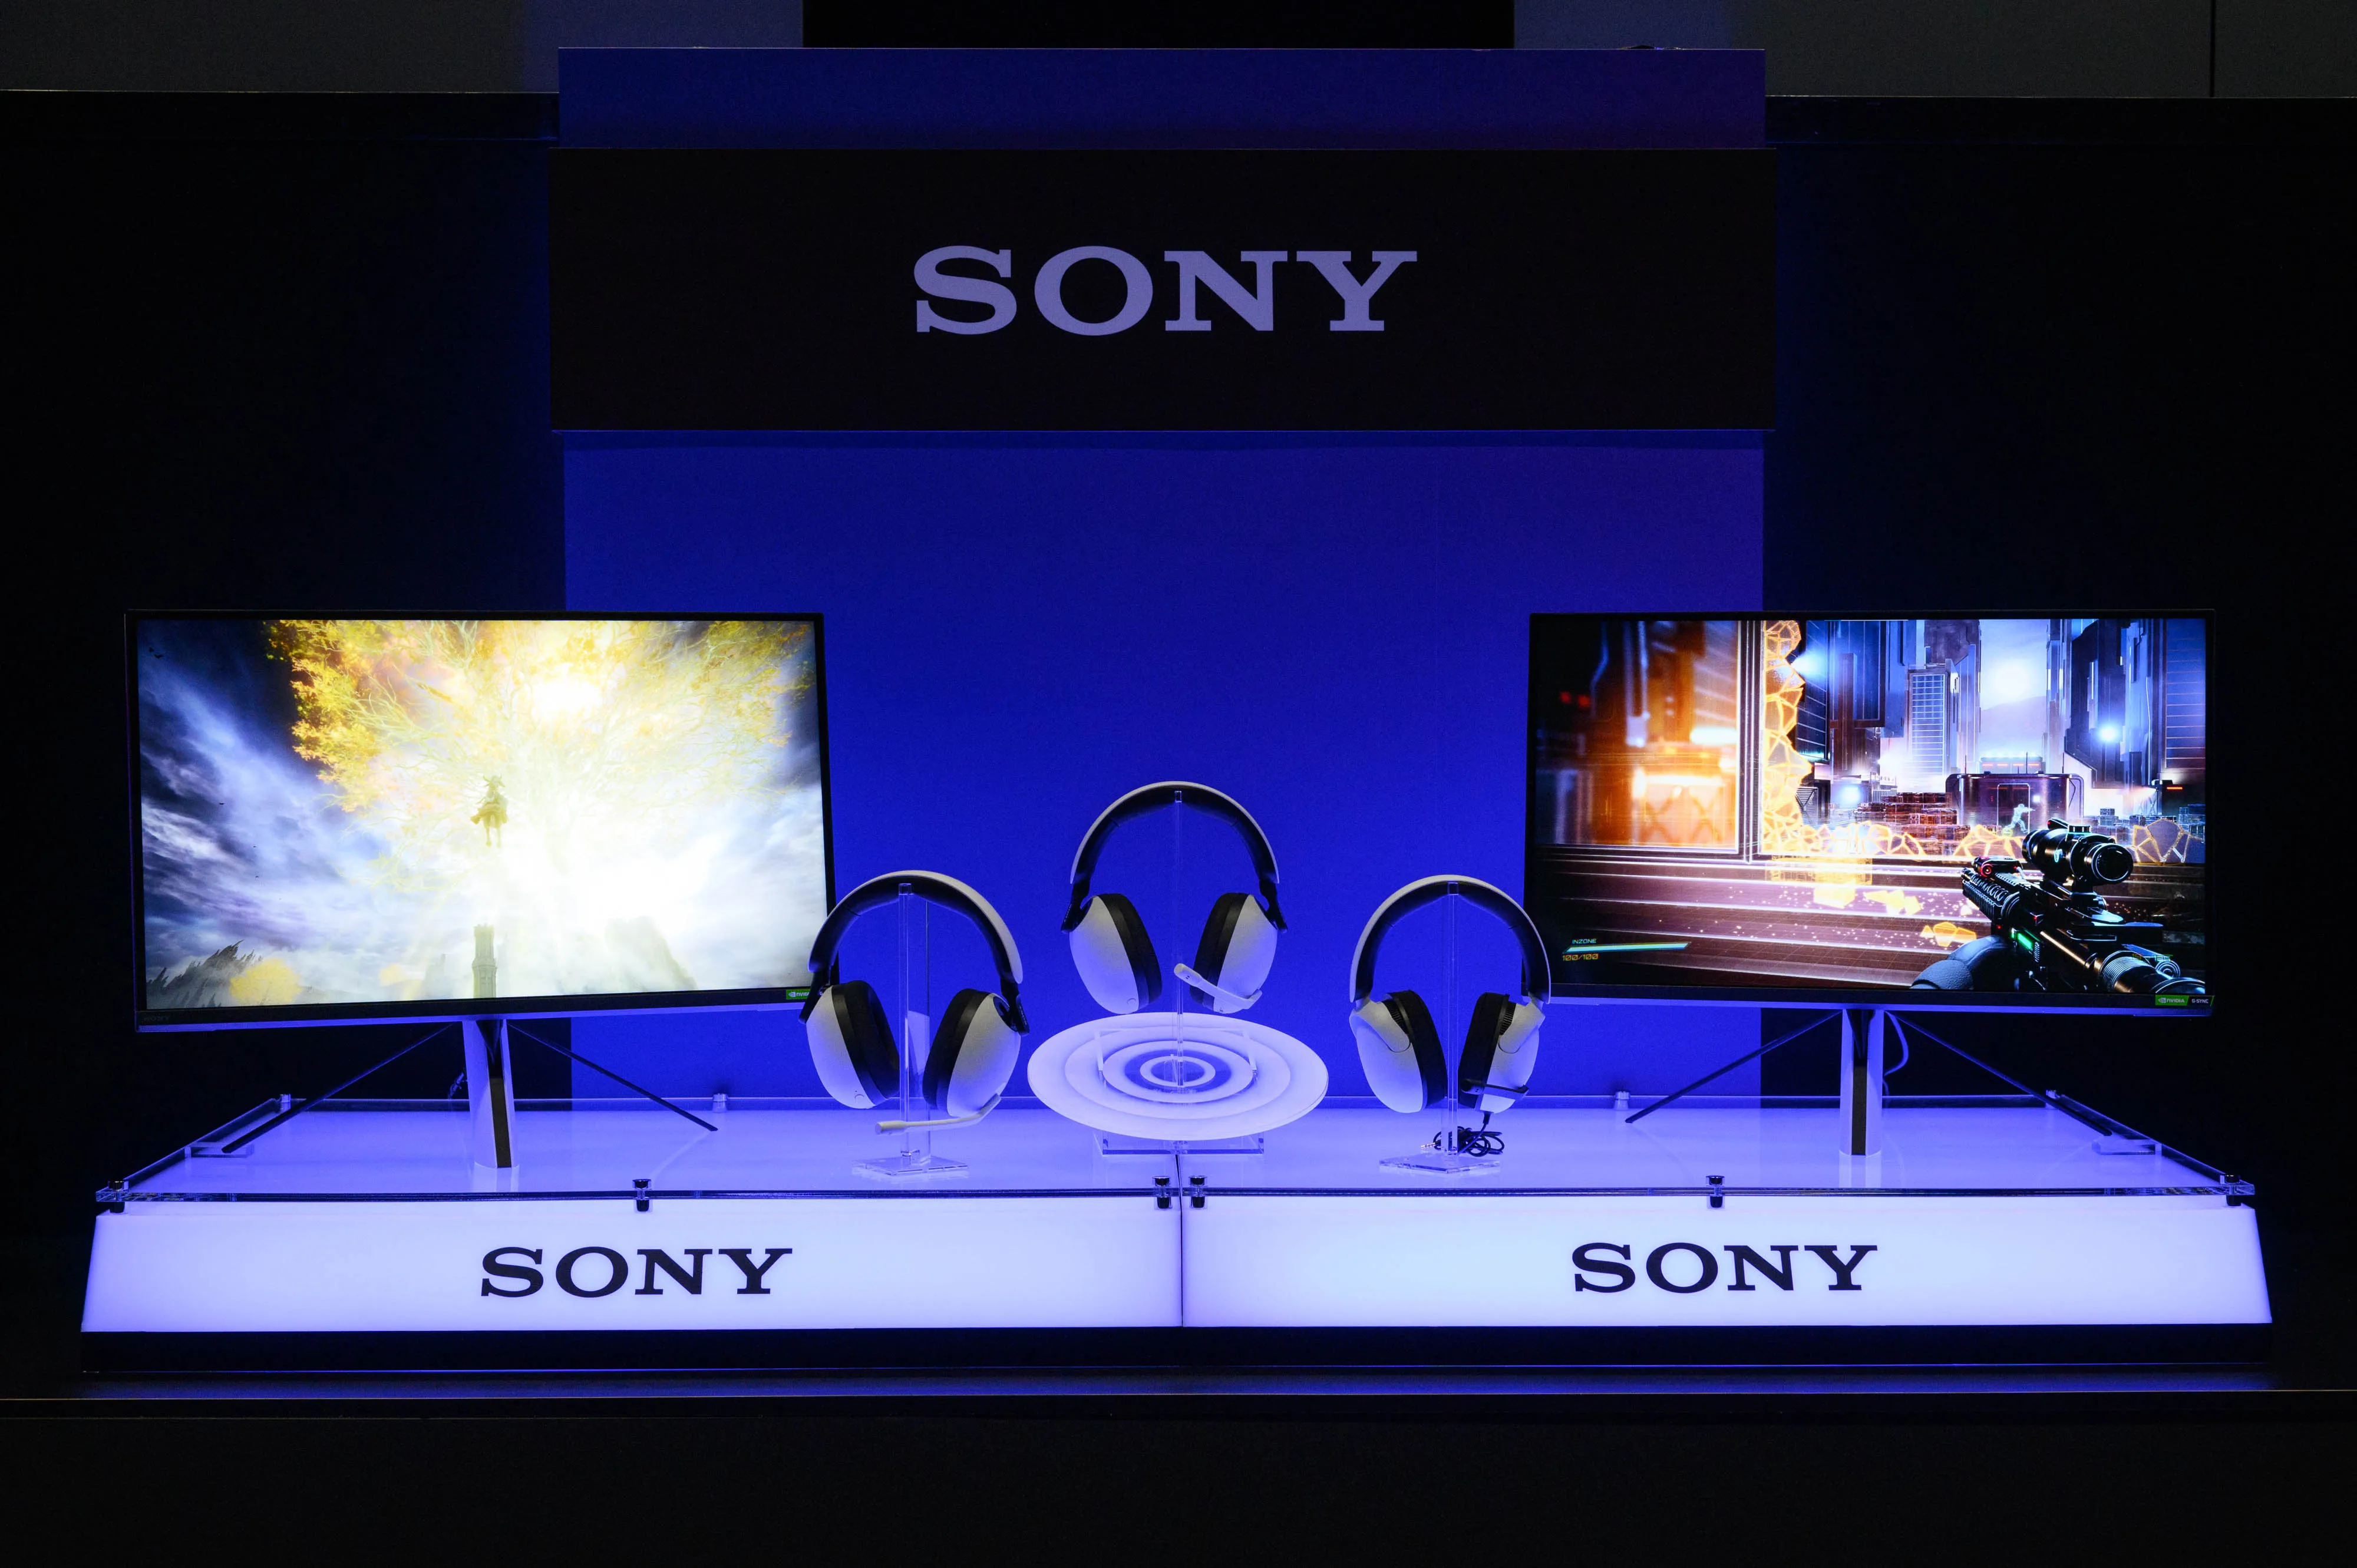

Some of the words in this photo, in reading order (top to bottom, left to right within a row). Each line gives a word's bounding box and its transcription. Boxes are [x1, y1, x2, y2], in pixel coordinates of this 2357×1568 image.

[914, 246, 1417, 335] SONY
[481, 1247, 792, 1298] SONY
[1572, 1243, 1877, 1293] SONY
